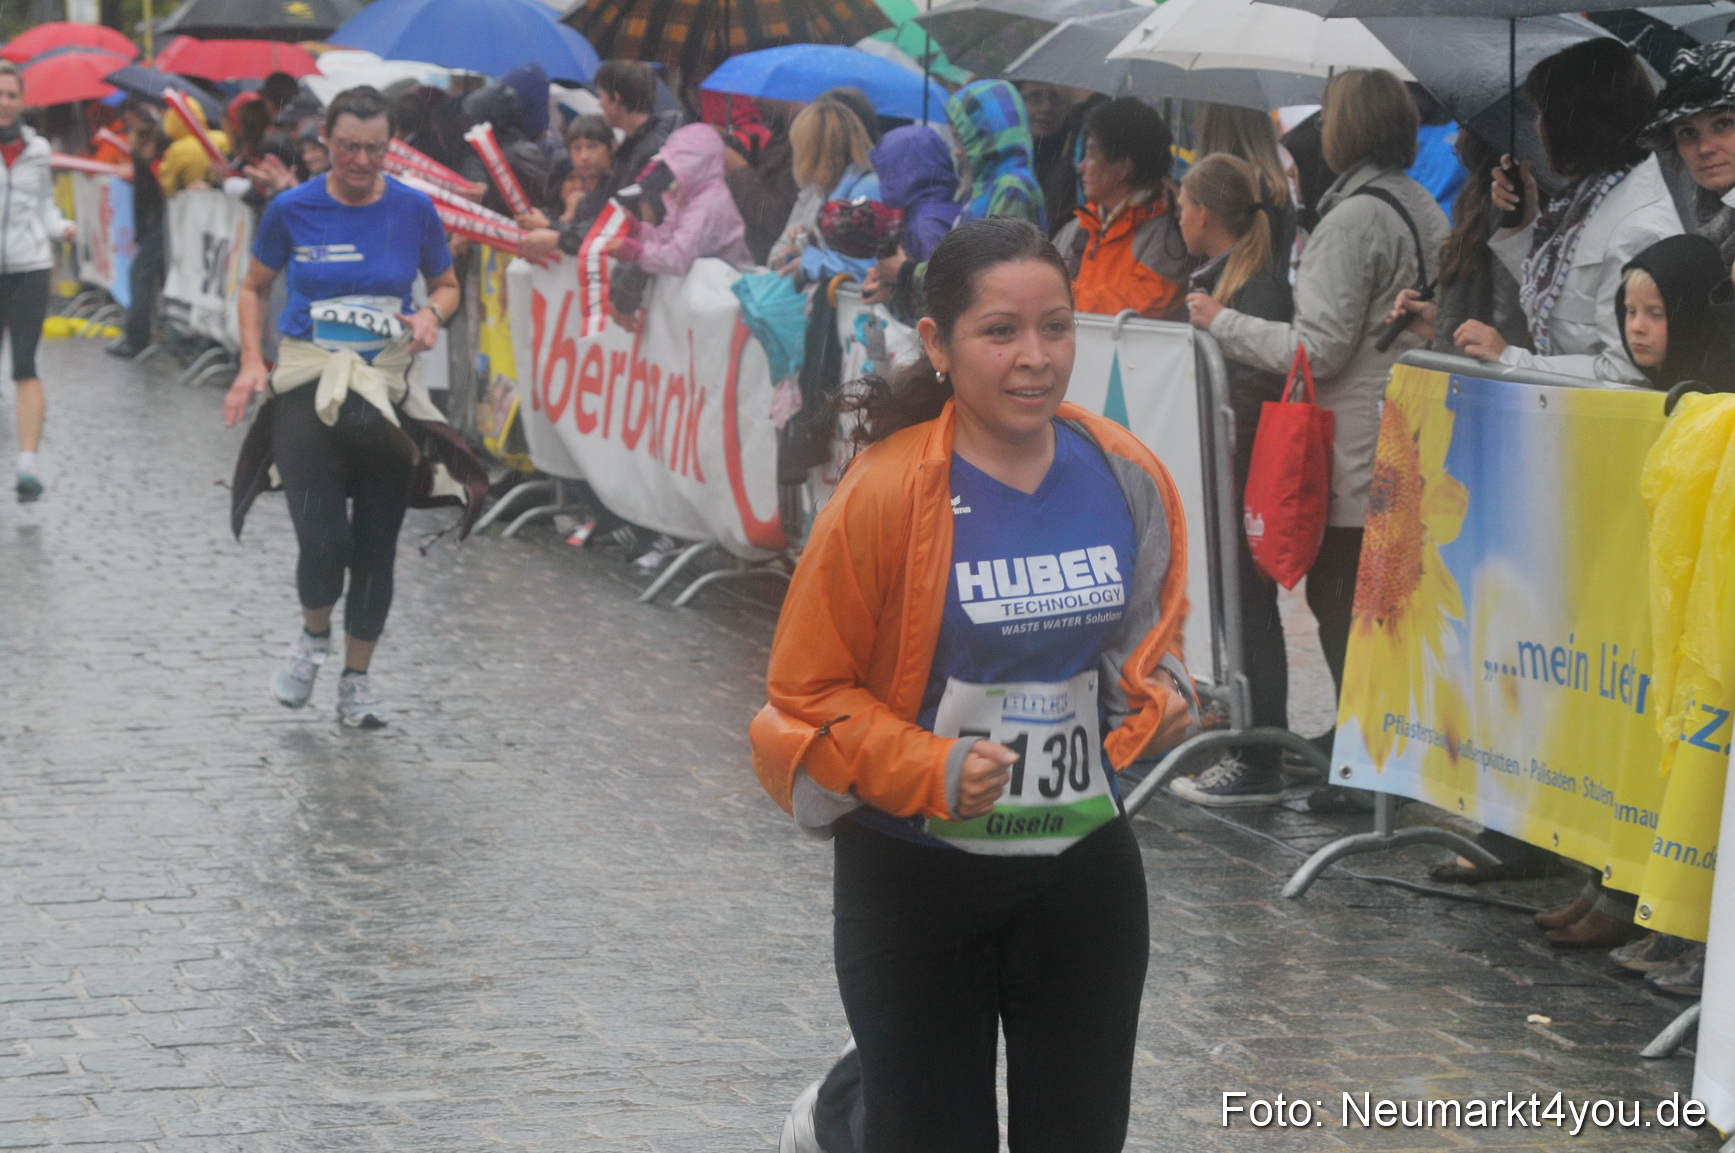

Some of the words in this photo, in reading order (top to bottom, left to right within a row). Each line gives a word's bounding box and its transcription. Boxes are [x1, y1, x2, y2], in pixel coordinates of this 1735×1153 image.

[955, 545, 1123, 602] HUBER
[1001, 588, 1121, 616] TECHNOLOGY
[1001, 622, 1039, 636] WASTE
[1043, 617, 1081, 631] WATER
[959, 724, 1089, 798] 130
[986, 812, 1064, 835] Gisela
